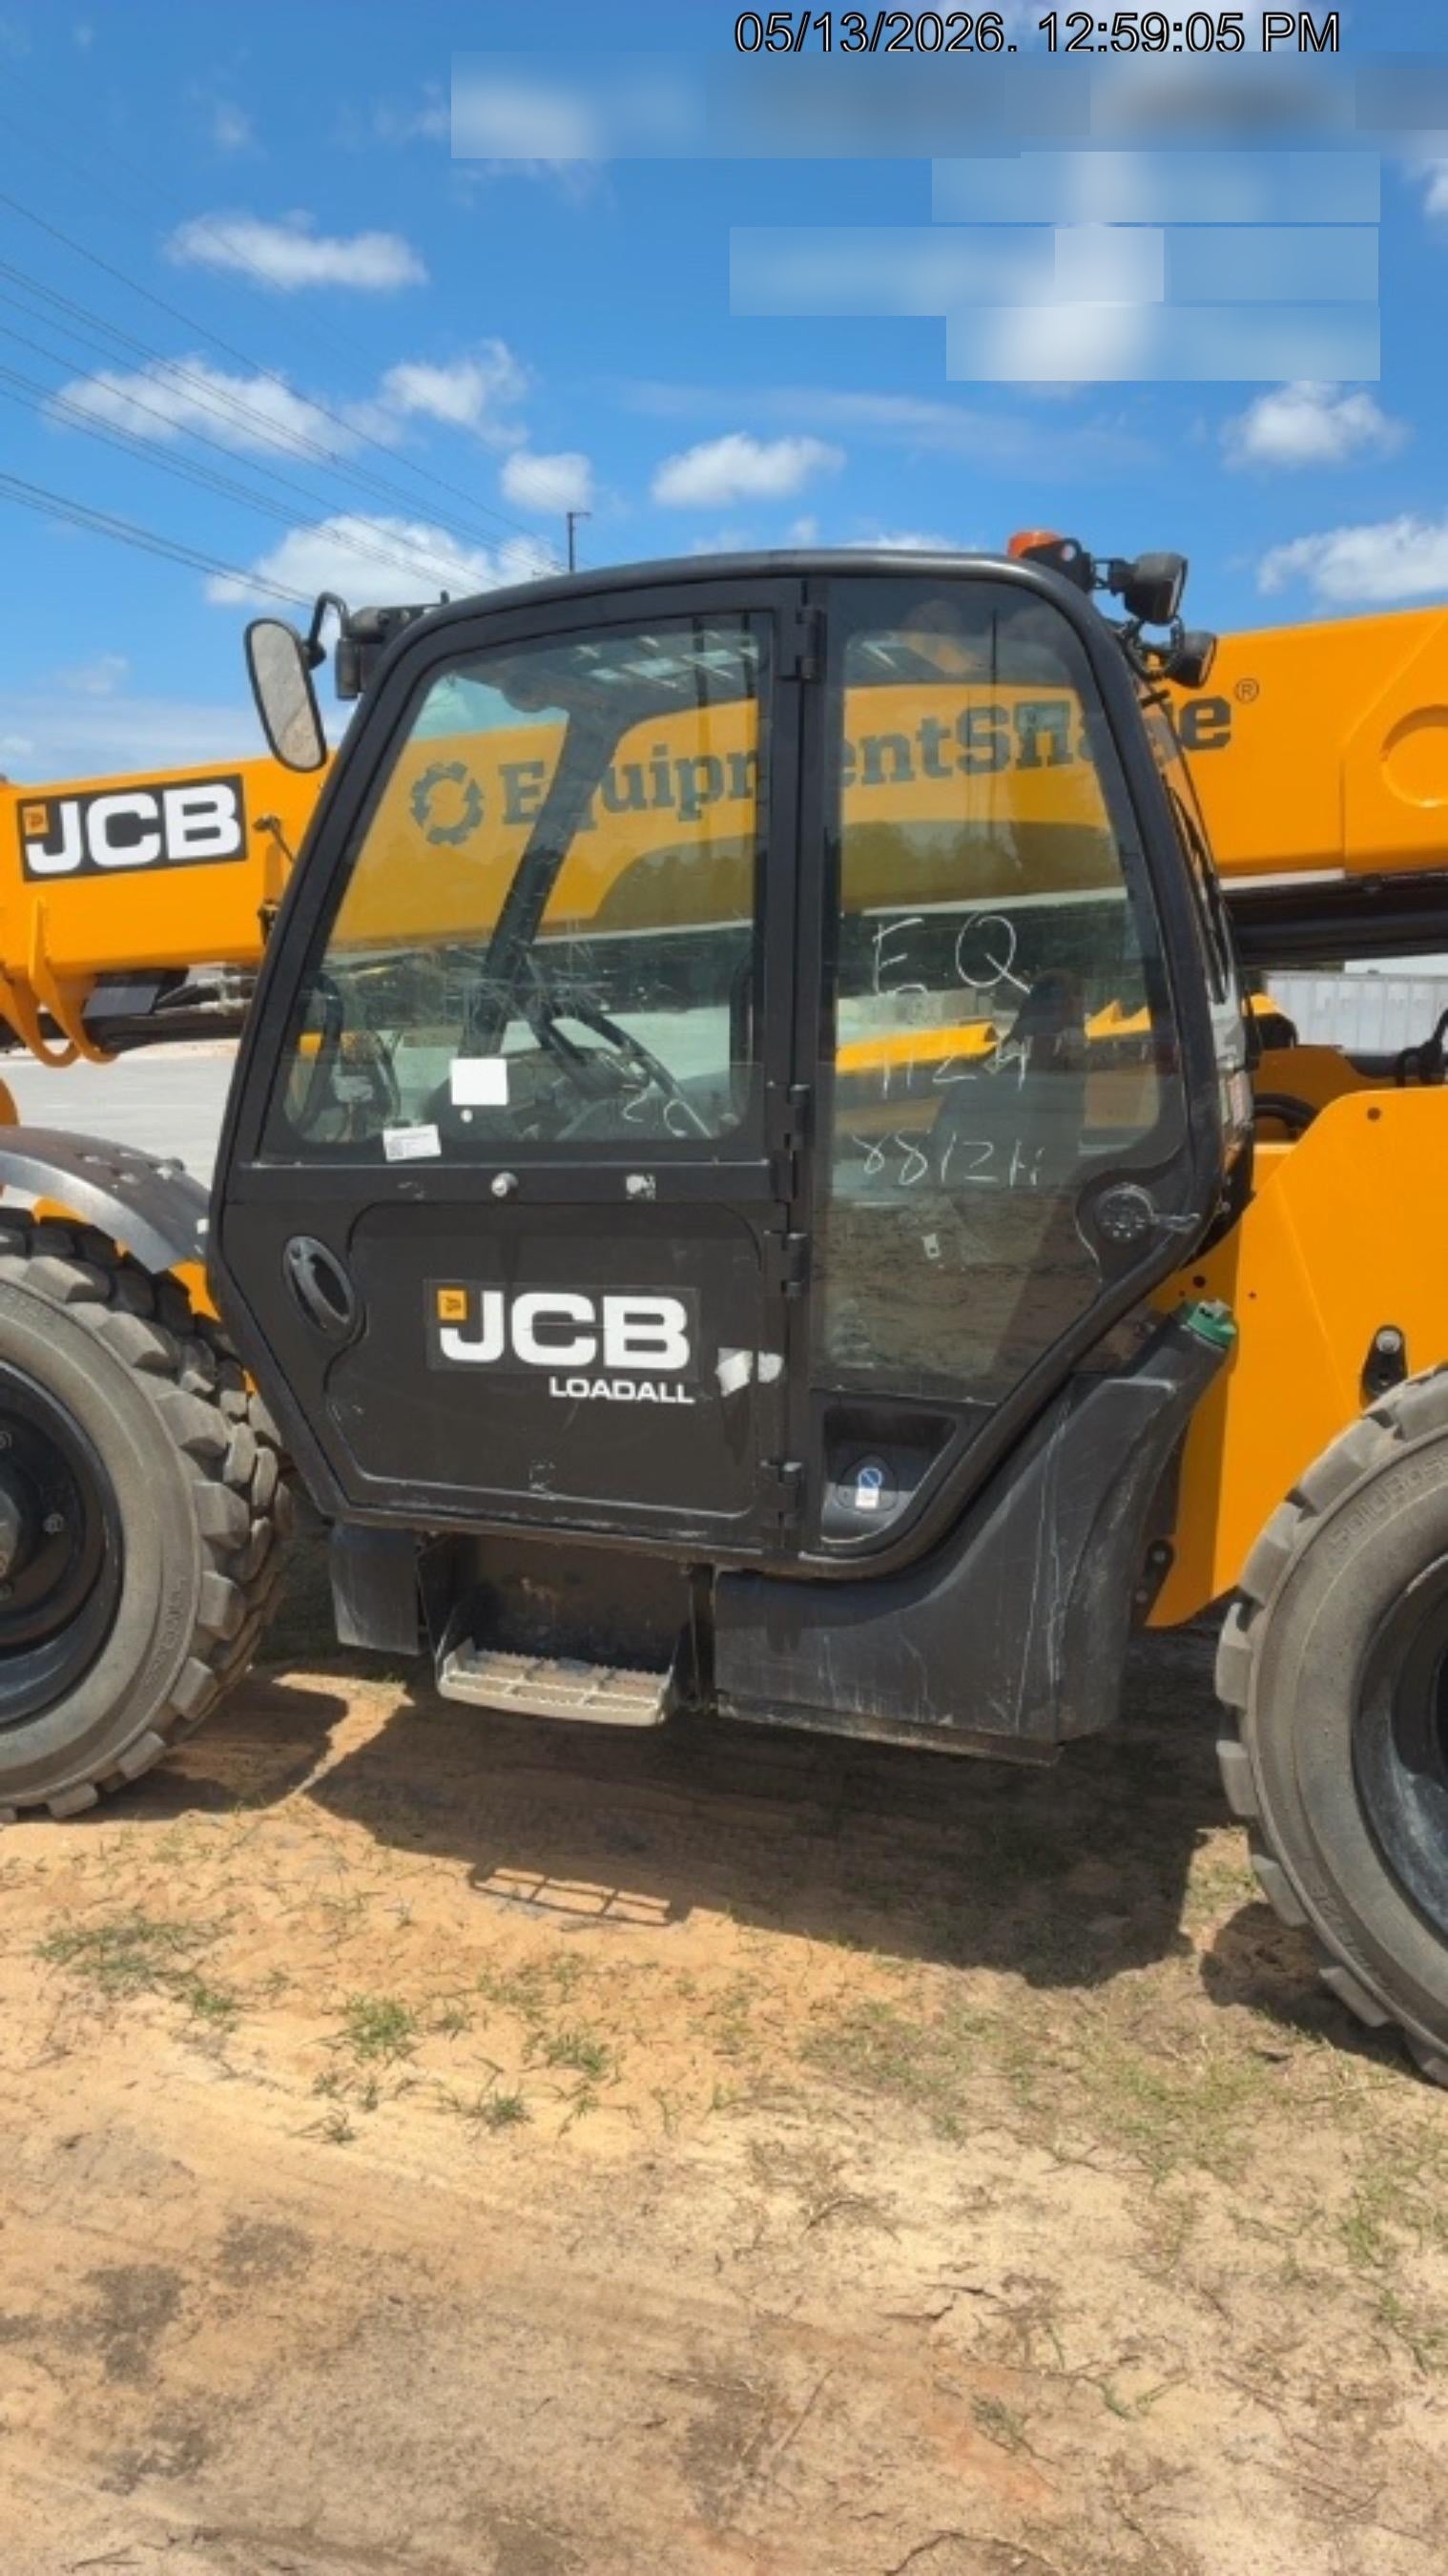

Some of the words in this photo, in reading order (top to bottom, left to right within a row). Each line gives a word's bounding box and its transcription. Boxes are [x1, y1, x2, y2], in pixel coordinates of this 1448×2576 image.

[25, 783, 241, 875] JCB
[872, 911, 1031, 996] EQ
[440, 1290, 691, 1370] JCB
[548, 1376, 695, 1404] LOADALL
